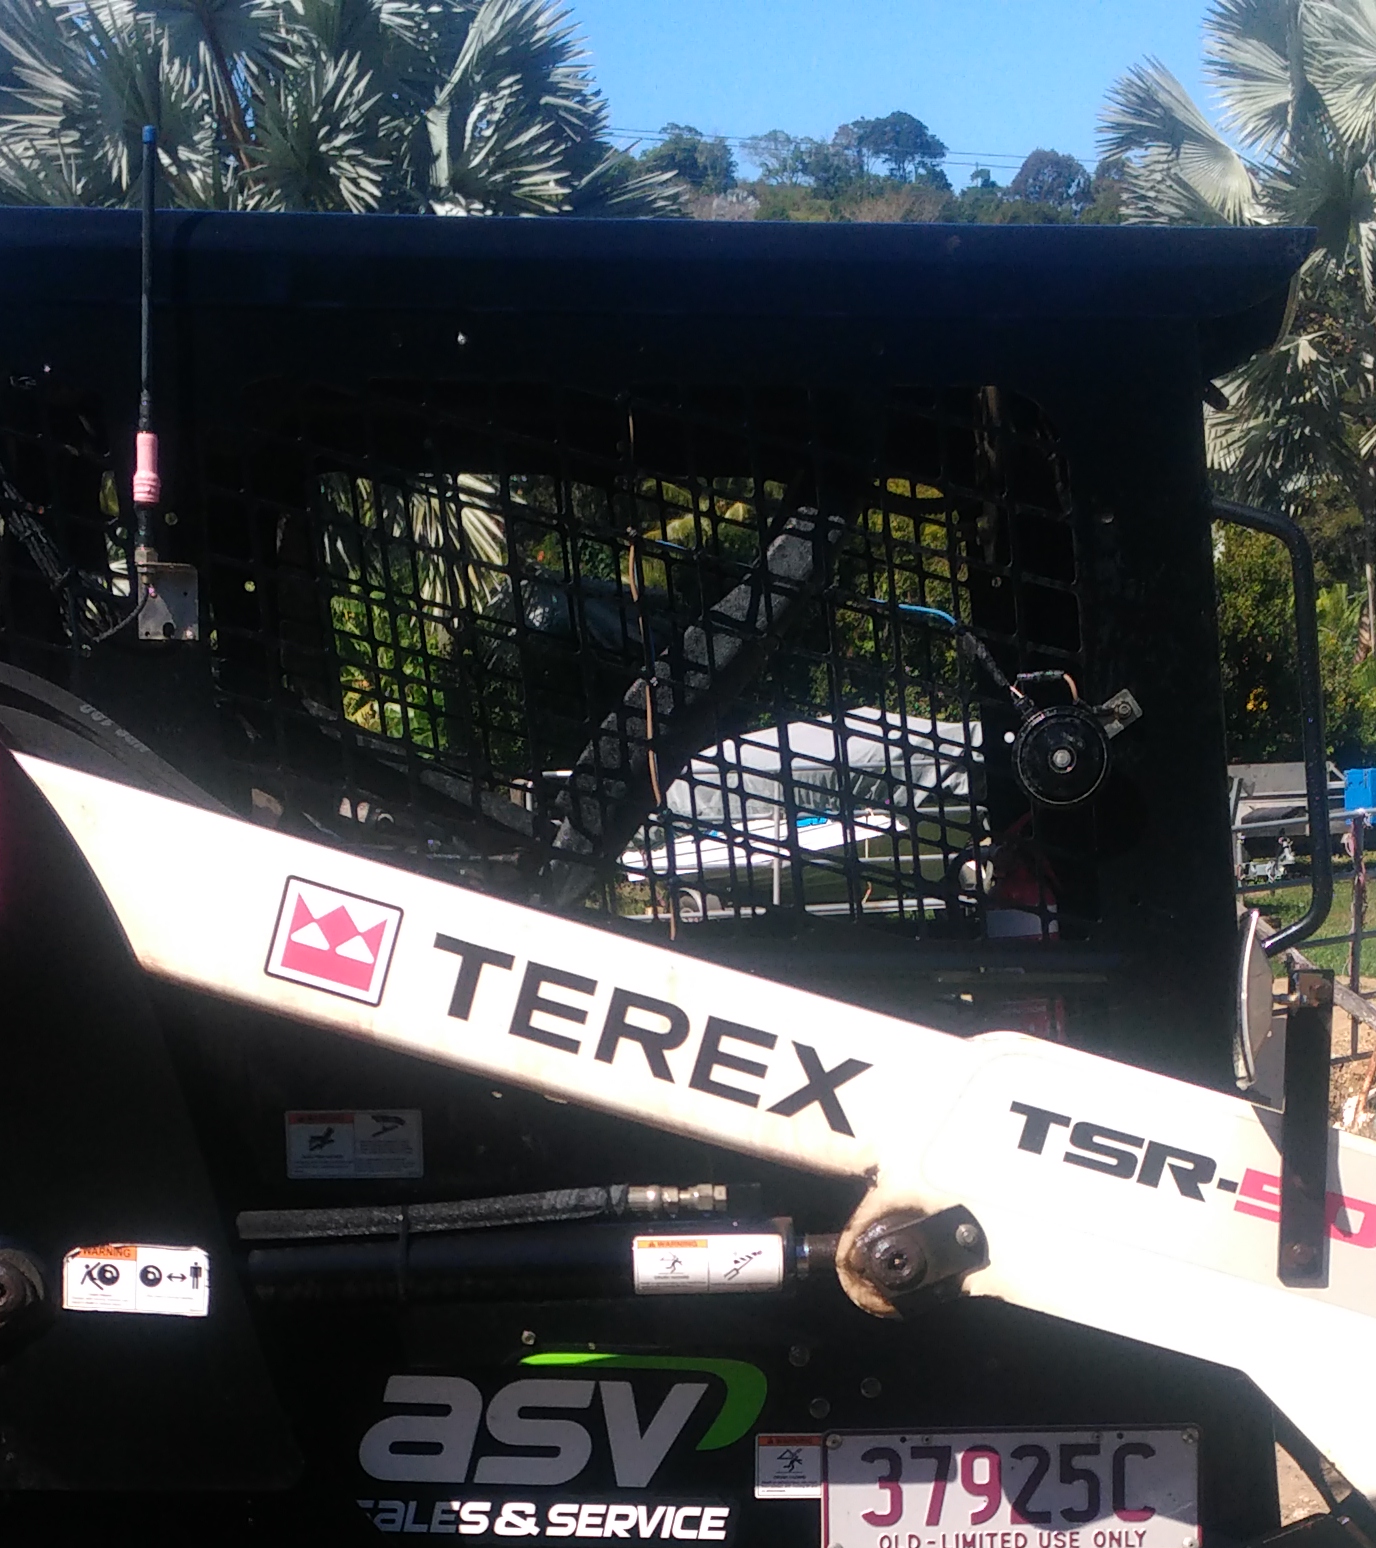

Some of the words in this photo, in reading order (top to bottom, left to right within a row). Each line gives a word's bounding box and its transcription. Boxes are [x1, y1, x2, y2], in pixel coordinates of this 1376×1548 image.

[433, 932, 874, 1138] TEREX
[82, 1245, 132, 1258] WARNING
[861, 1442, 1157, 1527] 37925C
[493, 1501, 541, 1537] &
[545, 1503, 730, 1541] SERVICE
[1092, 1528, 1147, 1548] ONLY
